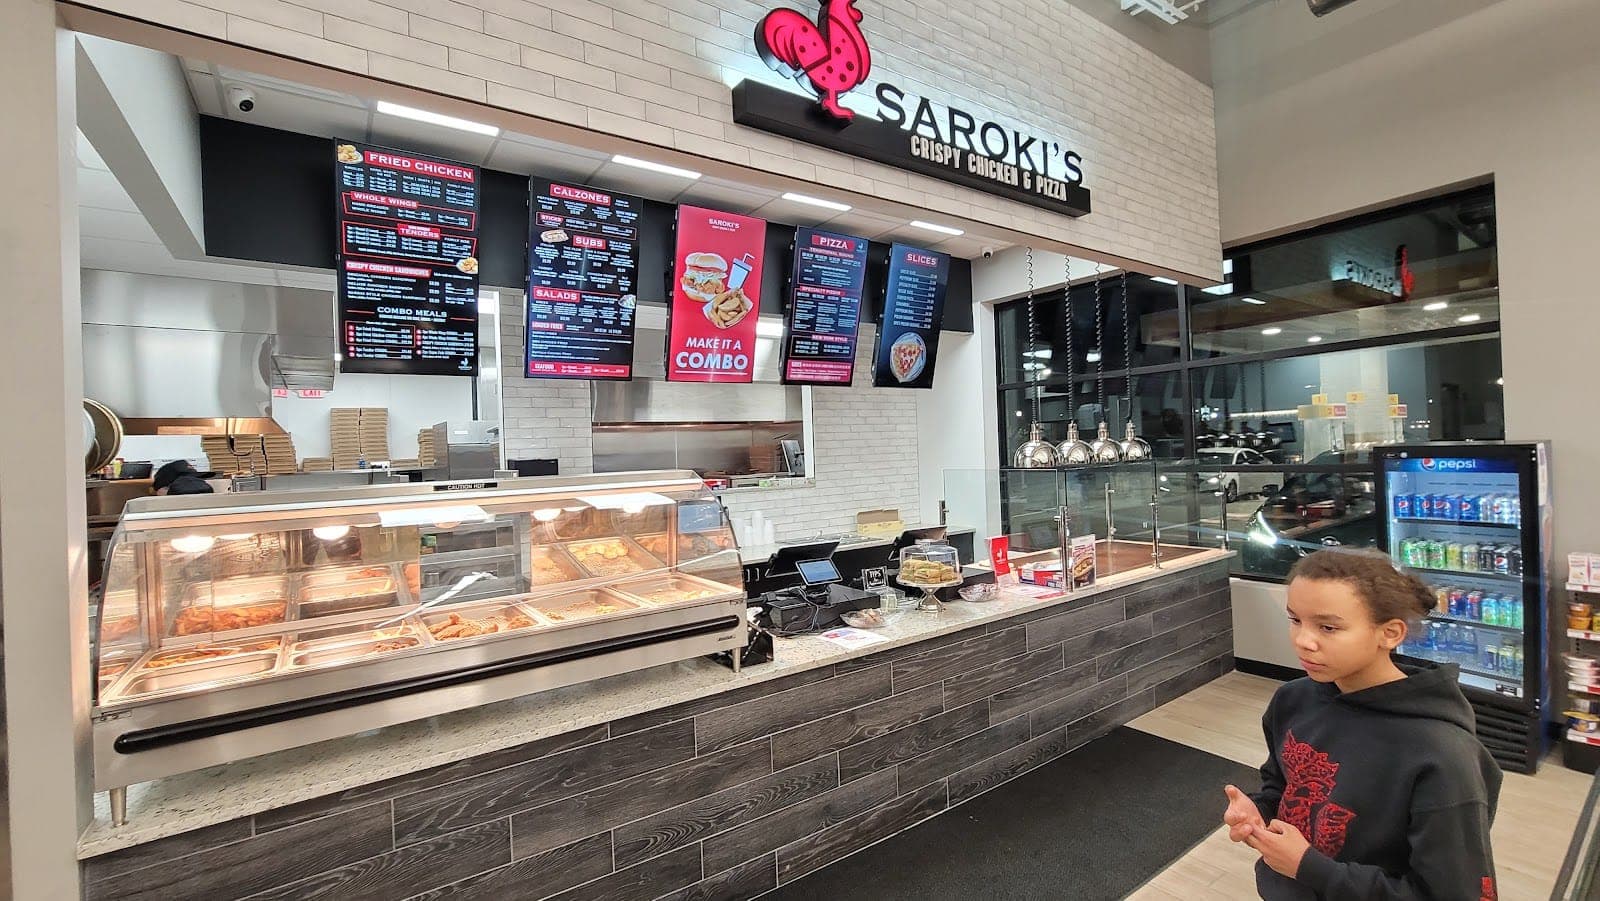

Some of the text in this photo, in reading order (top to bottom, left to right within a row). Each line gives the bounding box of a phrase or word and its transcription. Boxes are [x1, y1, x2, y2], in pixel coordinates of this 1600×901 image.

[875, 82, 1084, 185] SAROKI'S
[369, 153, 411, 168] FRIED
[415, 162, 473, 180] CHICKEN
[910, 135, 961, 169] CRISPY
[967, 154, 1019, 187] CHICKEN
[1036, 175, 1067, 202] PIZZA
[354, 193, 386, 203] WHOLE
[388, 198, 418, 208] WINGS
[553, 187, 610, 203] CALZONES
[400, 228, 440, 239] TENDERS
[575, 237, 603, 247] SUBS
[820, 237, 848, 249] PIZZA
[907, 253, 937, 265] SLICES
[535, 290, 578, 300] SALADS
[377, 306, 413, 315] COMBO
[415, 309, 448, 318] MEALS
[686, 337, 742, 350] MAKE IT A
[675, 351, 748, 370] COMBO
[1438, 459, 1476, 470] pepsi
